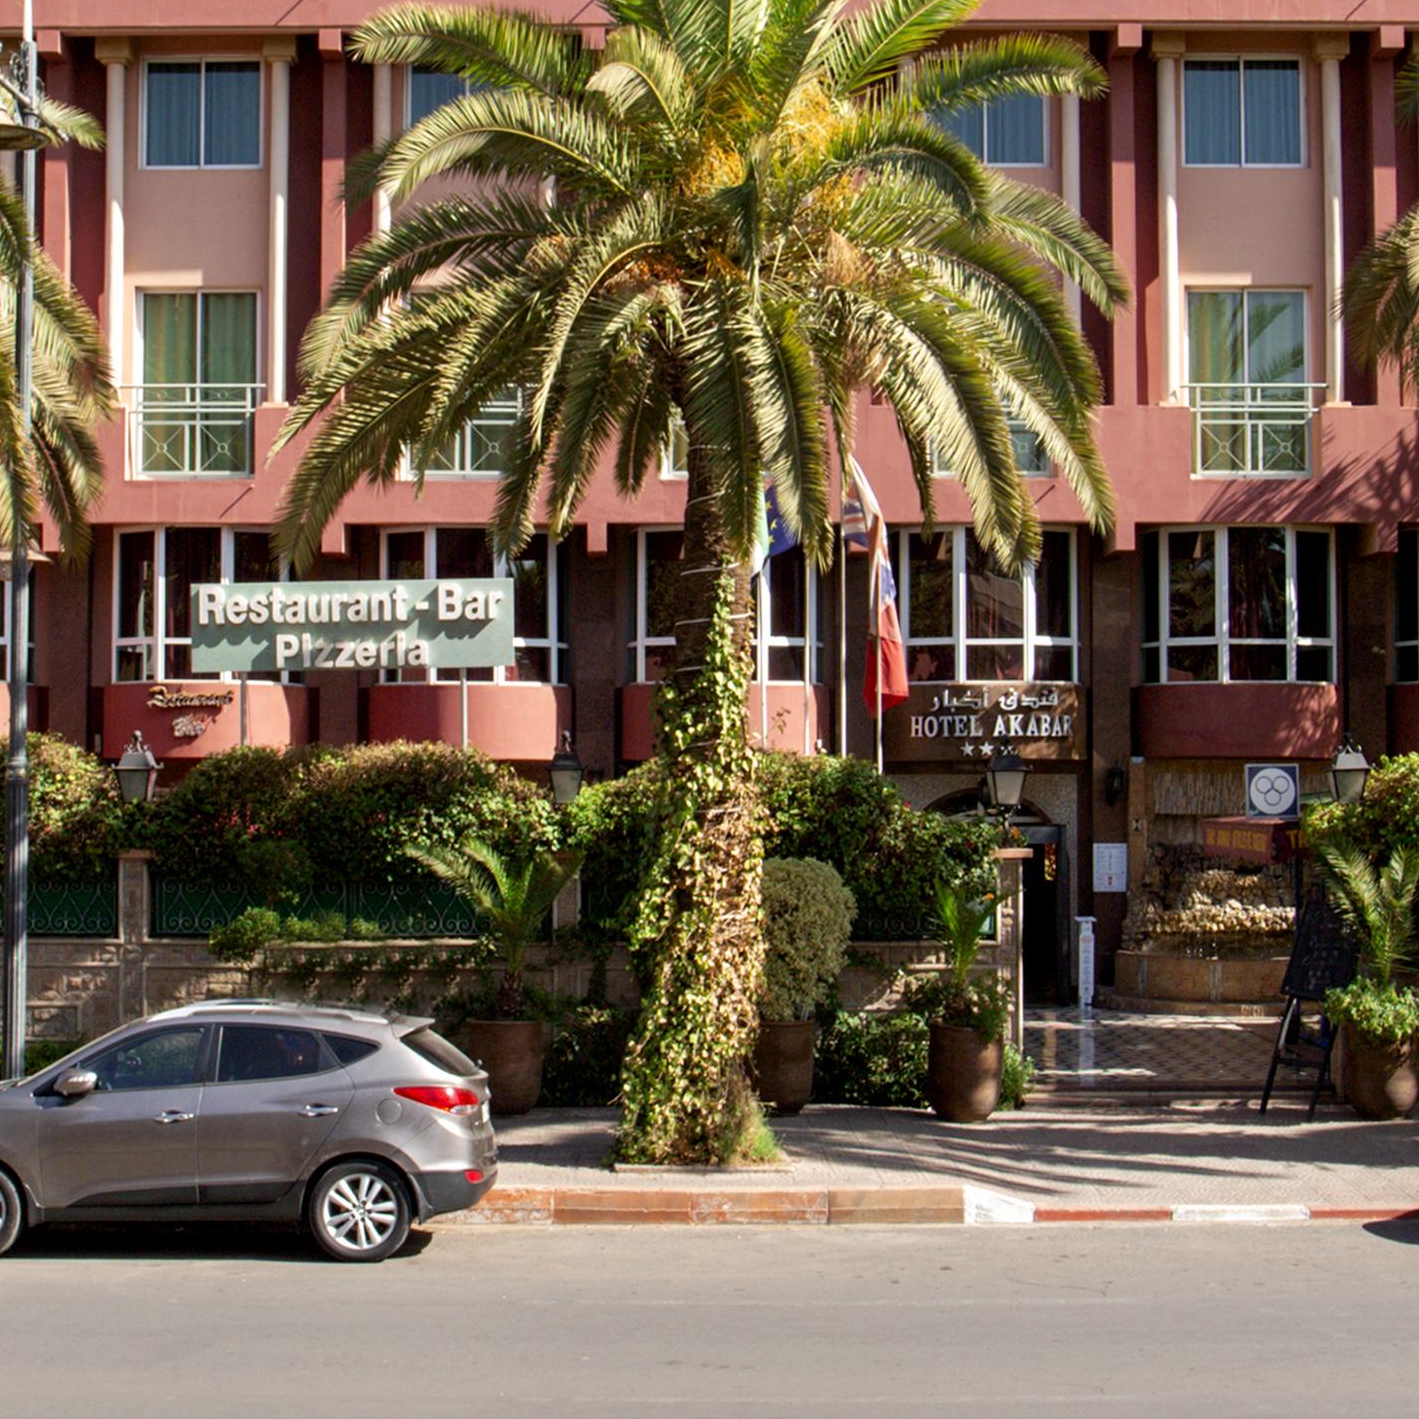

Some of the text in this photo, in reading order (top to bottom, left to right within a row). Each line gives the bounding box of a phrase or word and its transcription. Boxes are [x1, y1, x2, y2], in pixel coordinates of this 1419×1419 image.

[198, 584, 409, 625] Restaurant
[438, 582, 504, 621] Bar
[276, 631, 429, 668] Pizzeria
[910, 714, 1073, 738] HOTEL AKABAR
